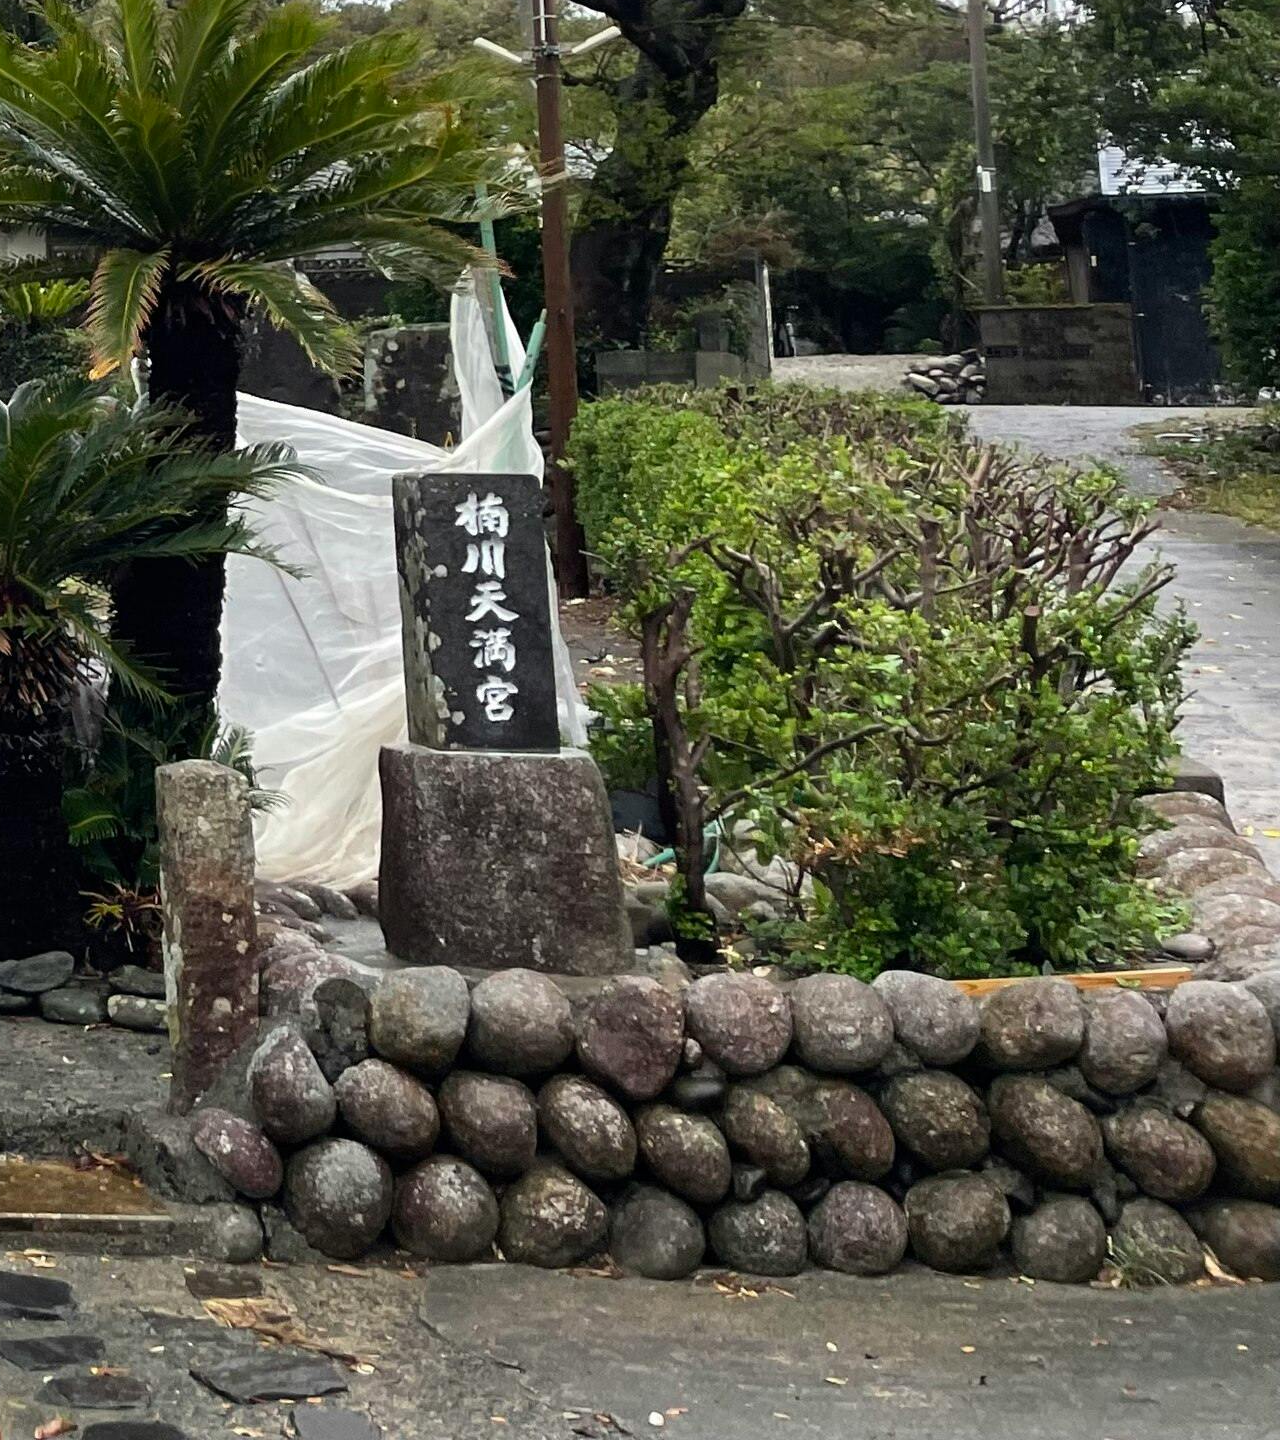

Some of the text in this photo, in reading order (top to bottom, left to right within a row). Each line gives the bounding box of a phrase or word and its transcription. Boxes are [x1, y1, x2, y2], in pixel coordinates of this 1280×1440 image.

[454, 492, 520, 722] 楠川天満宮
